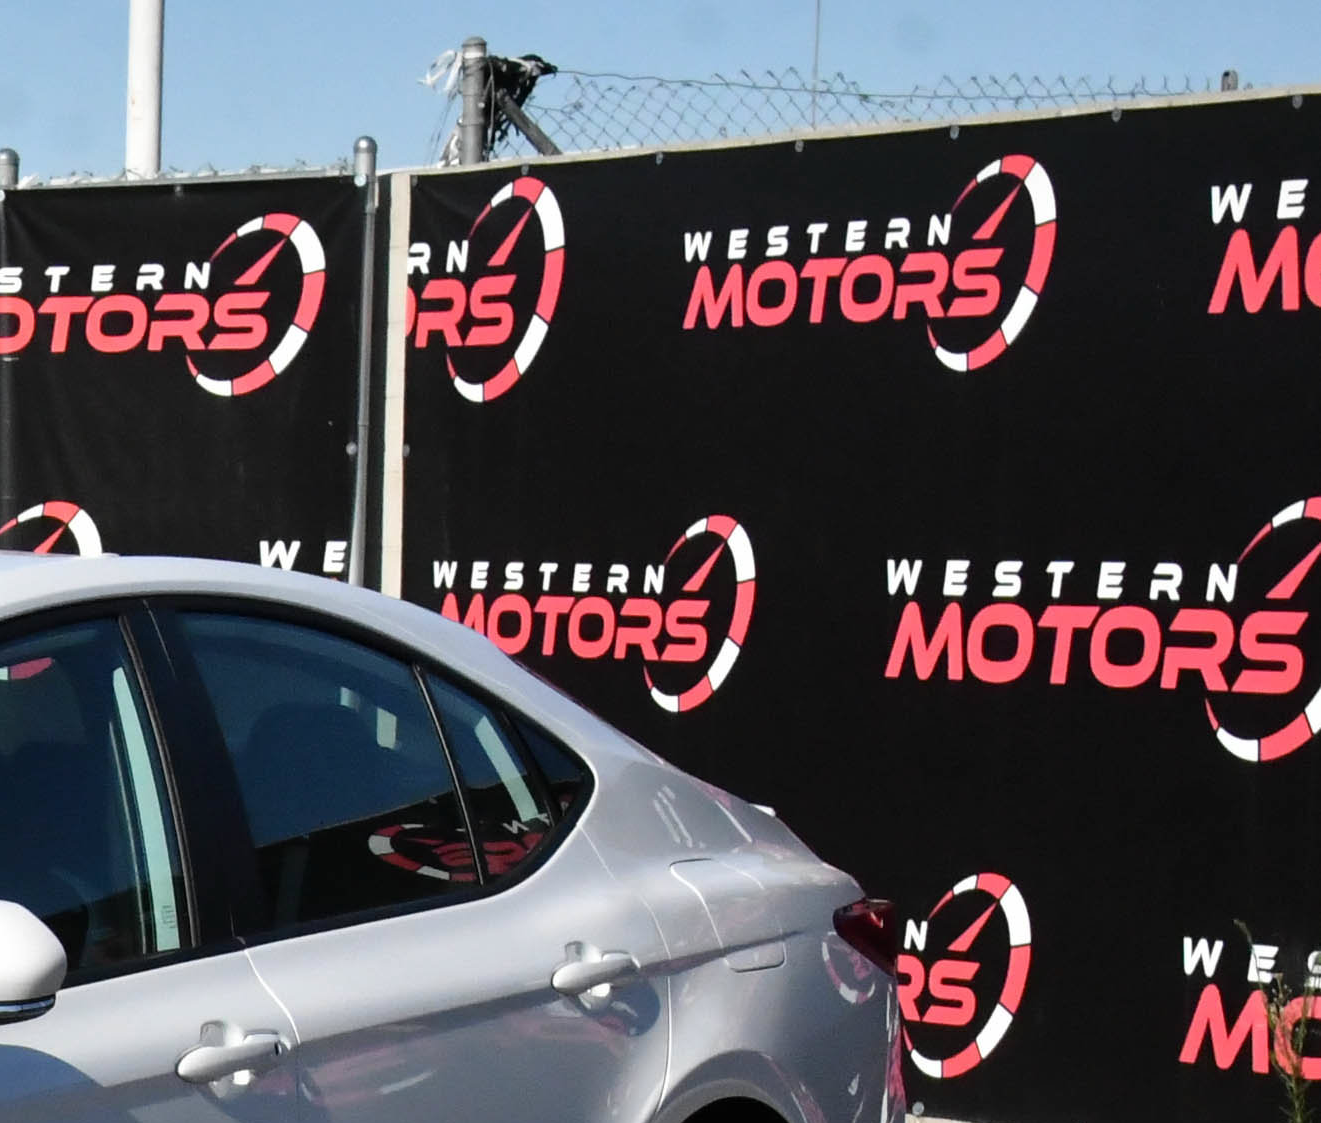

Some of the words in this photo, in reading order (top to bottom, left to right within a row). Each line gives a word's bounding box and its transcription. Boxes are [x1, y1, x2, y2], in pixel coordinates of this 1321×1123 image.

[685, 214, 951, 262] WESTERN
[1208, 225, 1321, 314] M
[405, 274, 516, 348] RS
[684, 248, 1004, 329] MOTORS
[434, 561, 664, 594] WESTERN
[887, 559, 1237, 602] WESTERN
[885, 601, 1308, 694] MOTORS
